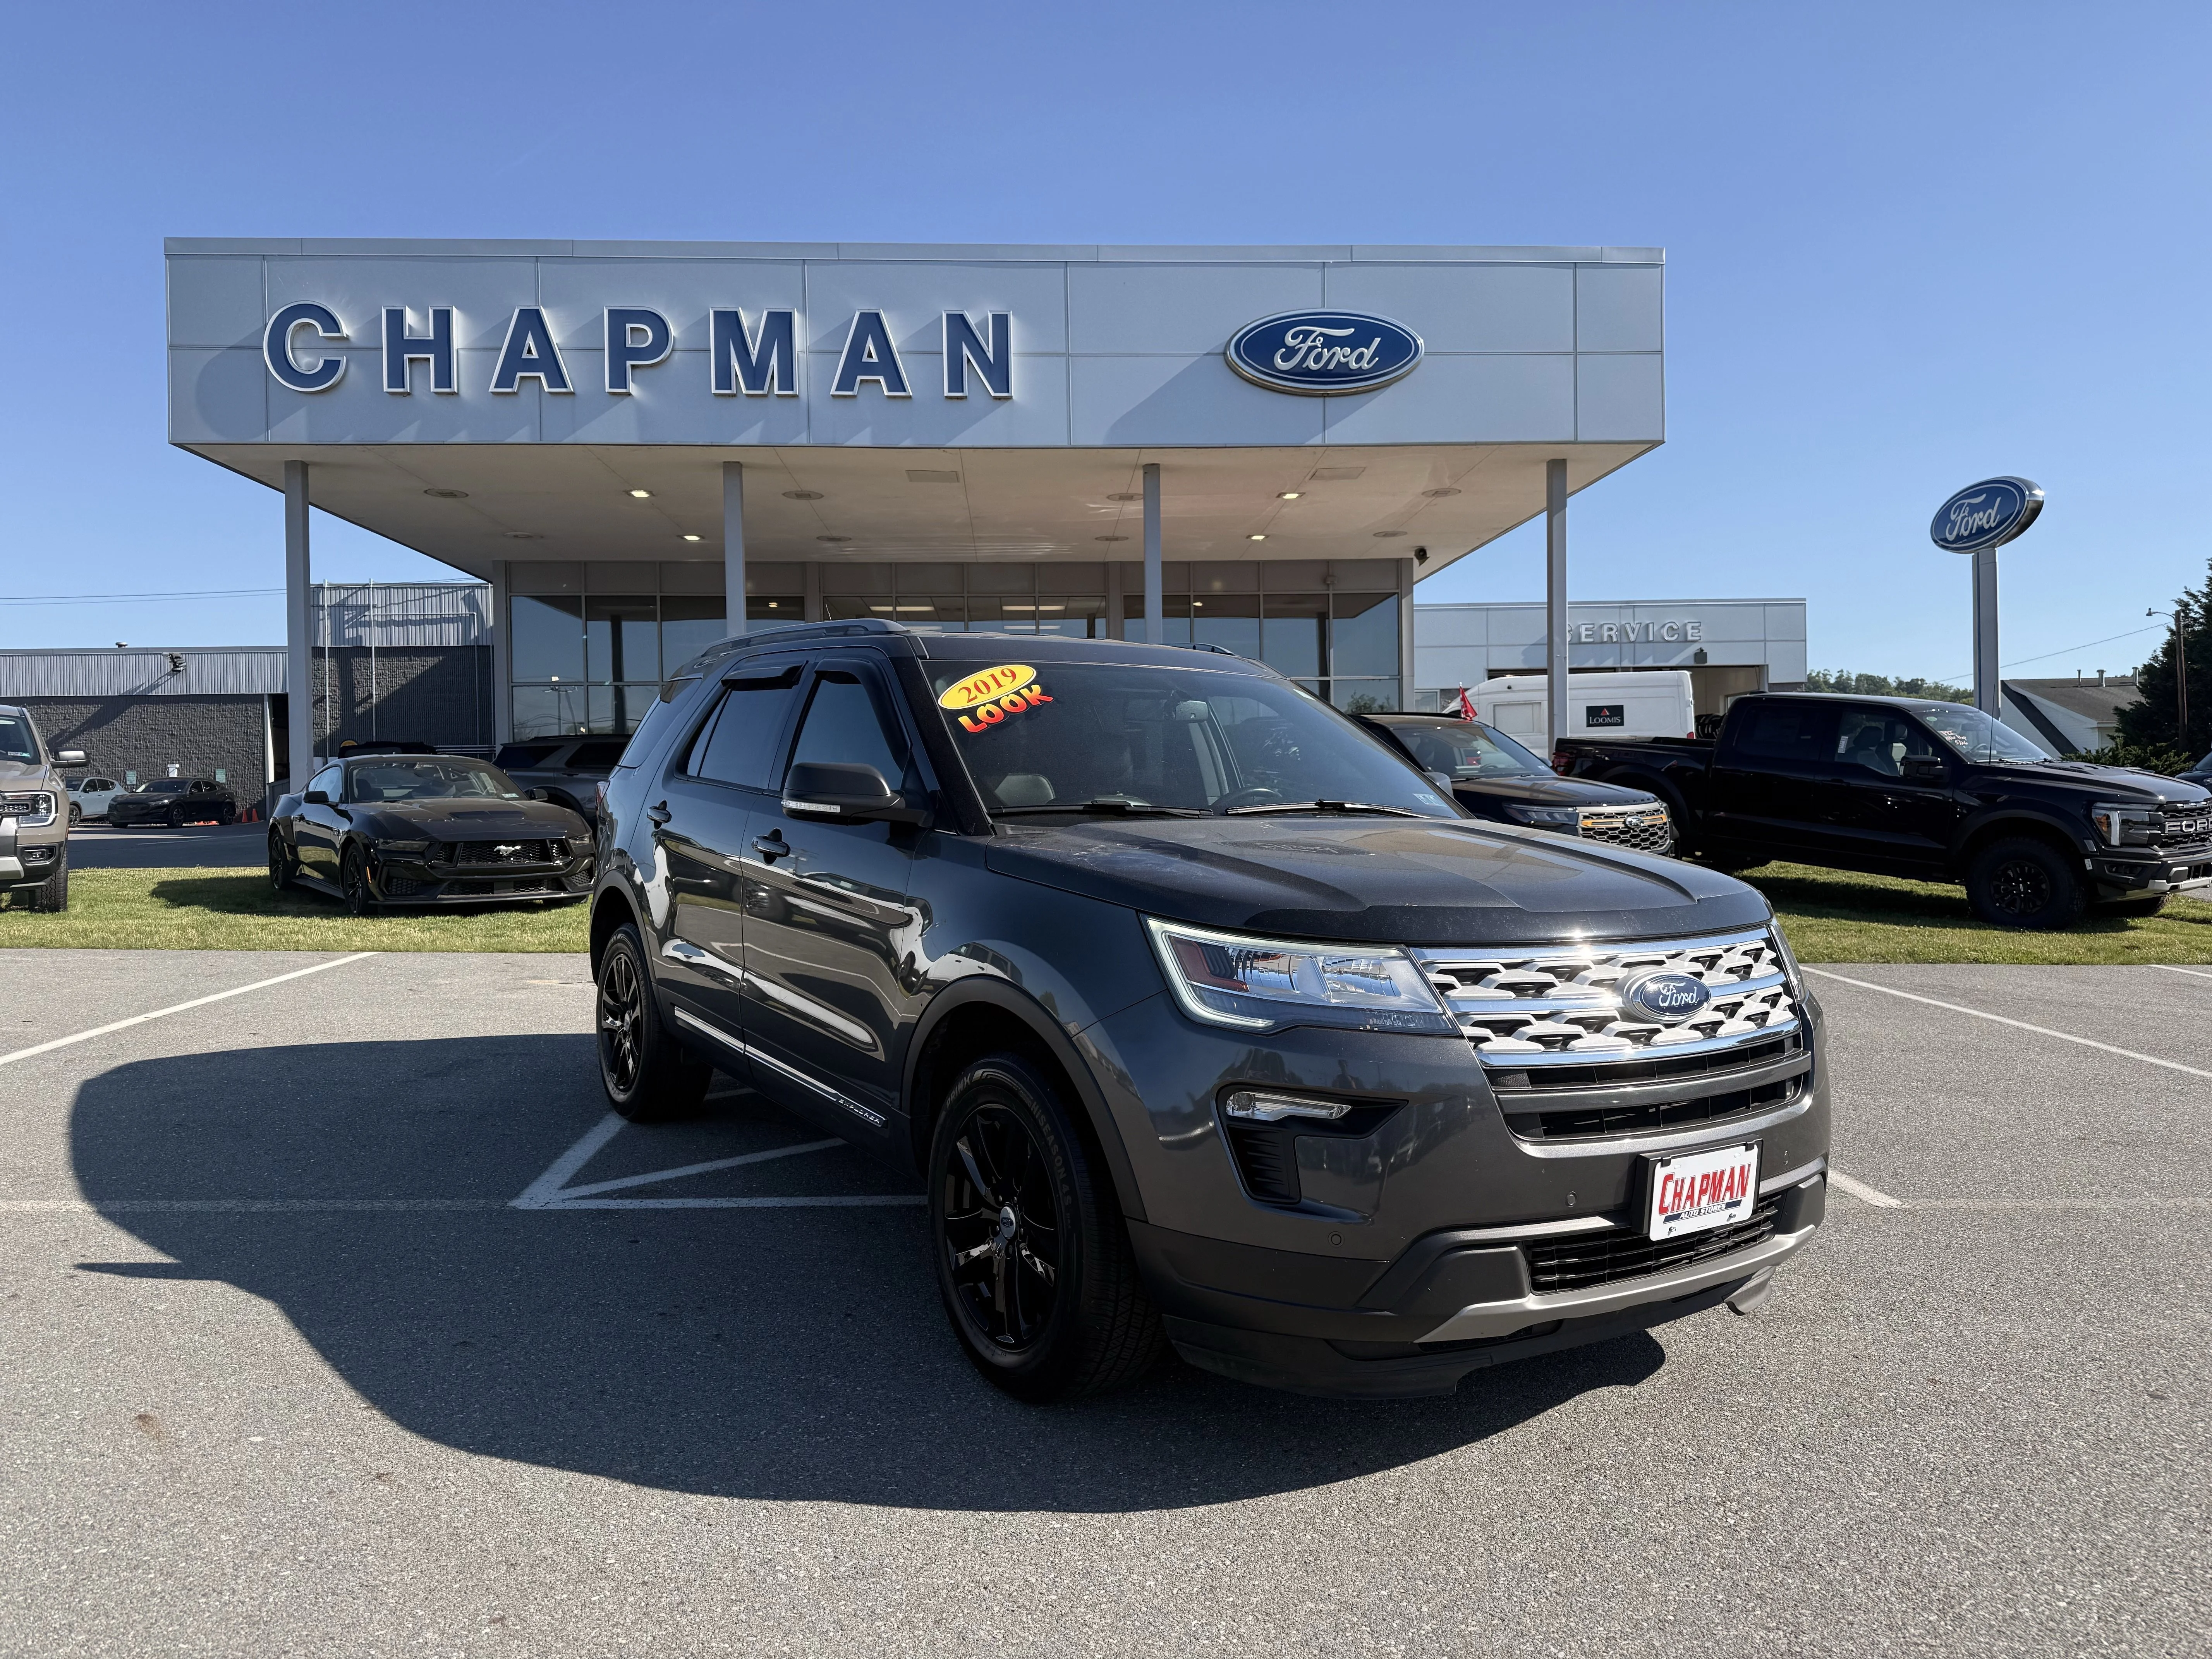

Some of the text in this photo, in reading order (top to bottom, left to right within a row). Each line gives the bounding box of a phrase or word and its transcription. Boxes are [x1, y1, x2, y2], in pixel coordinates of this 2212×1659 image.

[263, 300, 1013, 398] CHAPMAN
[1273, 326, 1382, 371] Ford
[1945, 493, 2002, 541] Ford
[958, 668, 1017, 704] 2019
[958, 684, 1054, 733] LOOK
[1589, 716, 1621, 724] LOOMIS
[1659, 982, 1699, 1007] Ford
[1659, 1163, 1751, 1216] CHAPMAN
[1679, 1203, 1726, 1219] AUTO STORES
